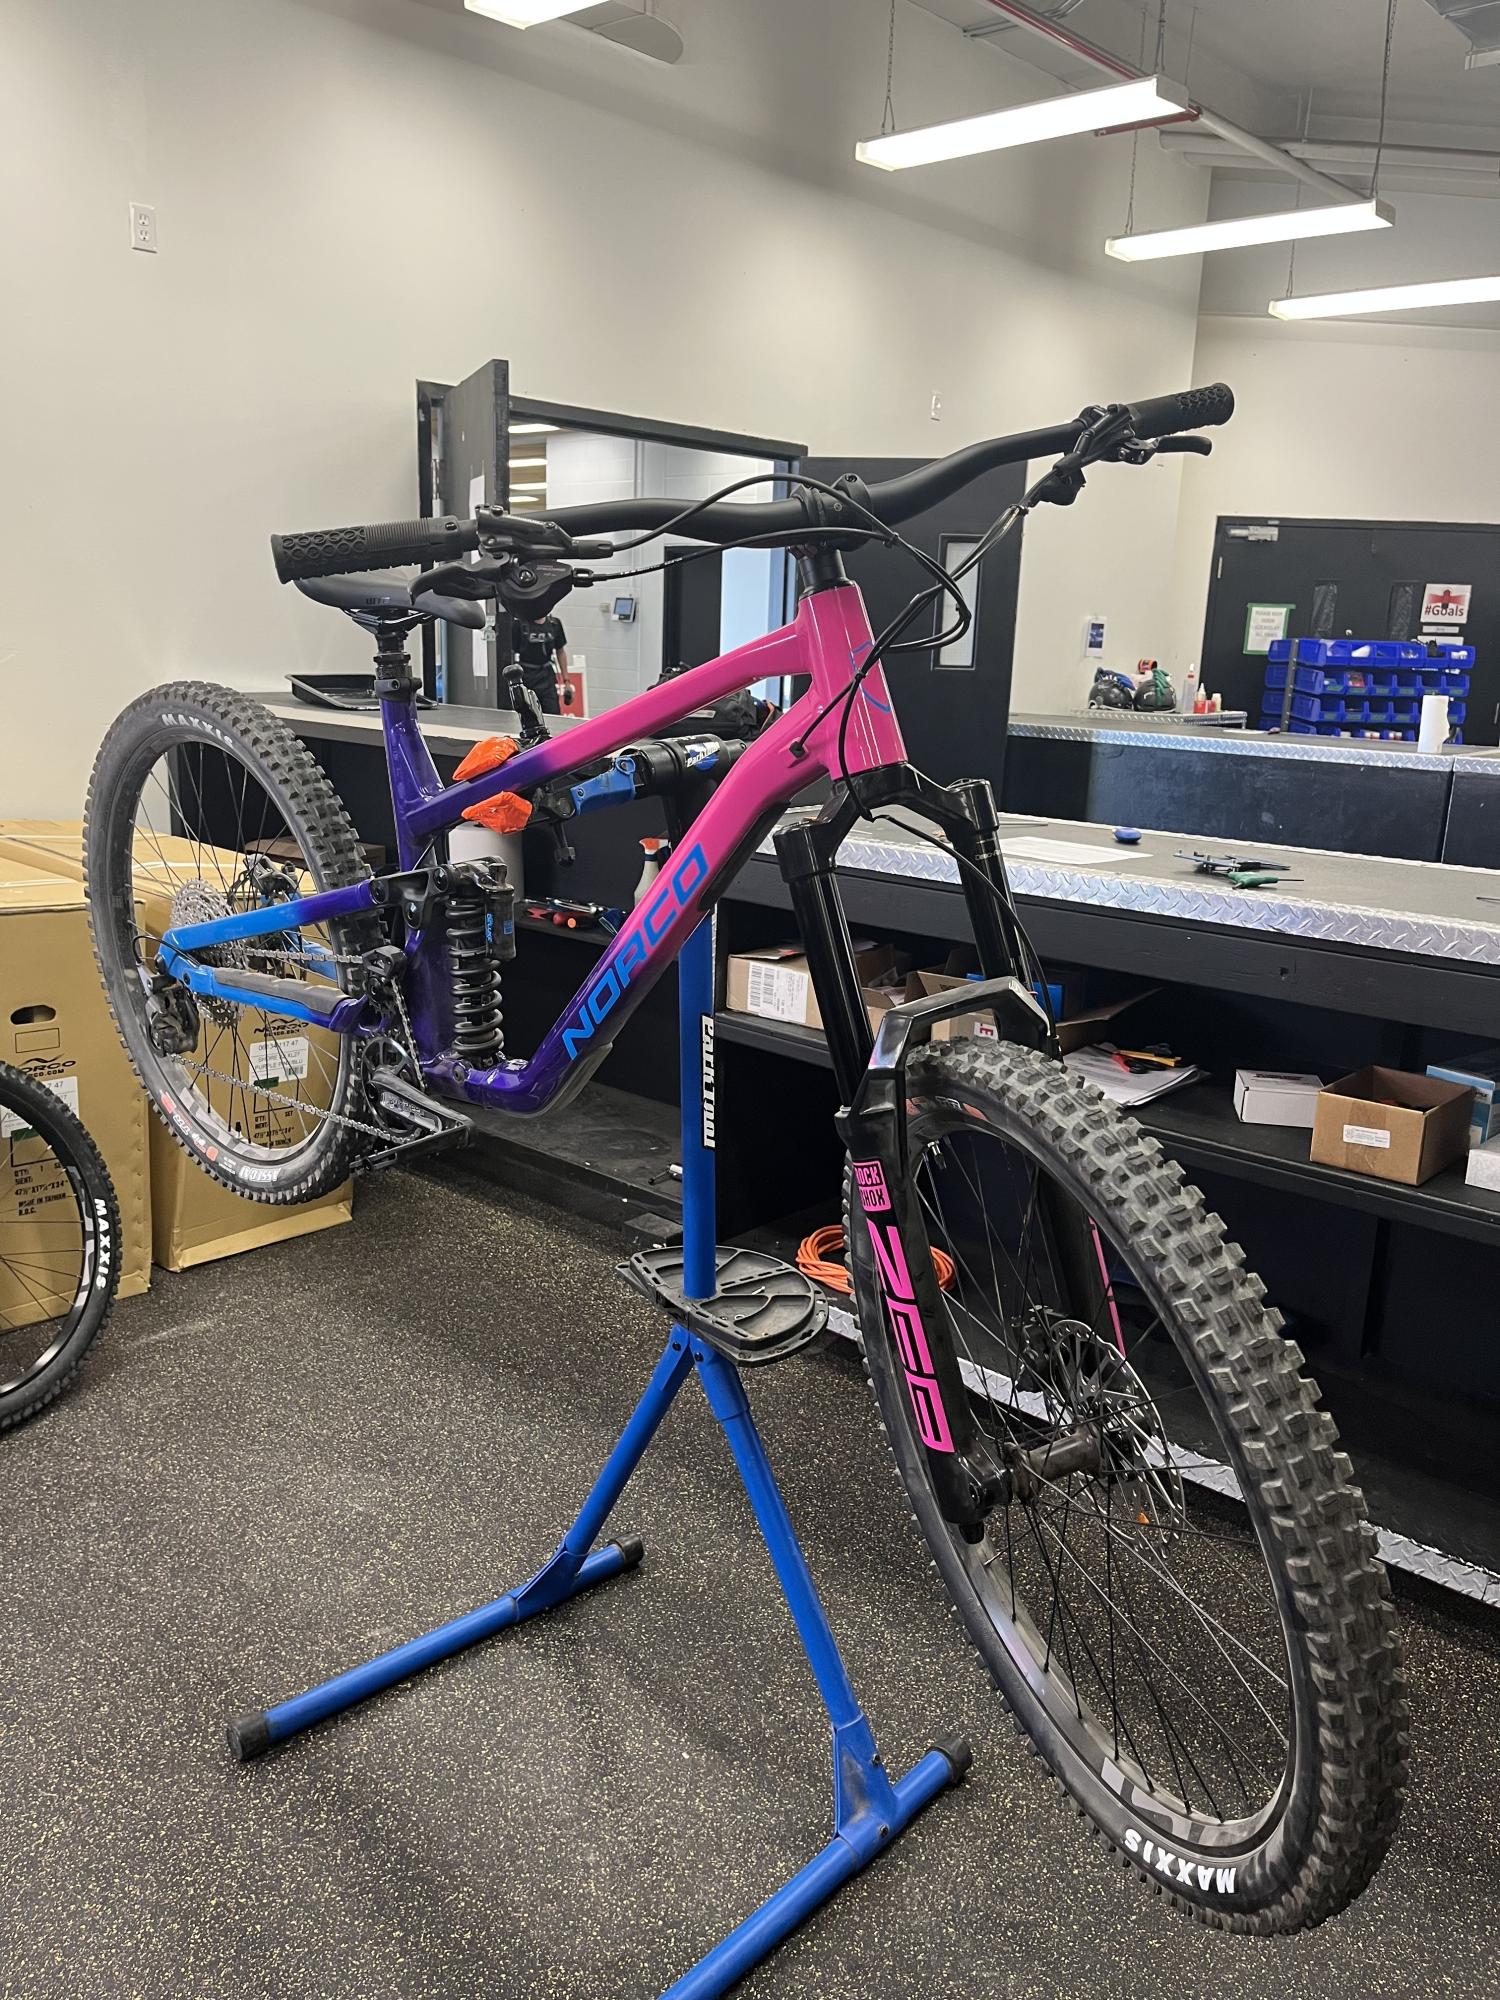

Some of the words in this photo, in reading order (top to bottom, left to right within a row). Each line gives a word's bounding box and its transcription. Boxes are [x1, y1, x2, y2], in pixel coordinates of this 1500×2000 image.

[1425, 604, 1464, 616] #Goals
[161, 713, 234, 749] MAXXIS
[561, 842, 709, 1060] NORCO
[21, 1060, 76, 1075] ORCO
[94, 1198, 111, 1289] MAXXIS
[1124, 1828, 1237, 1894] MAXXIS
